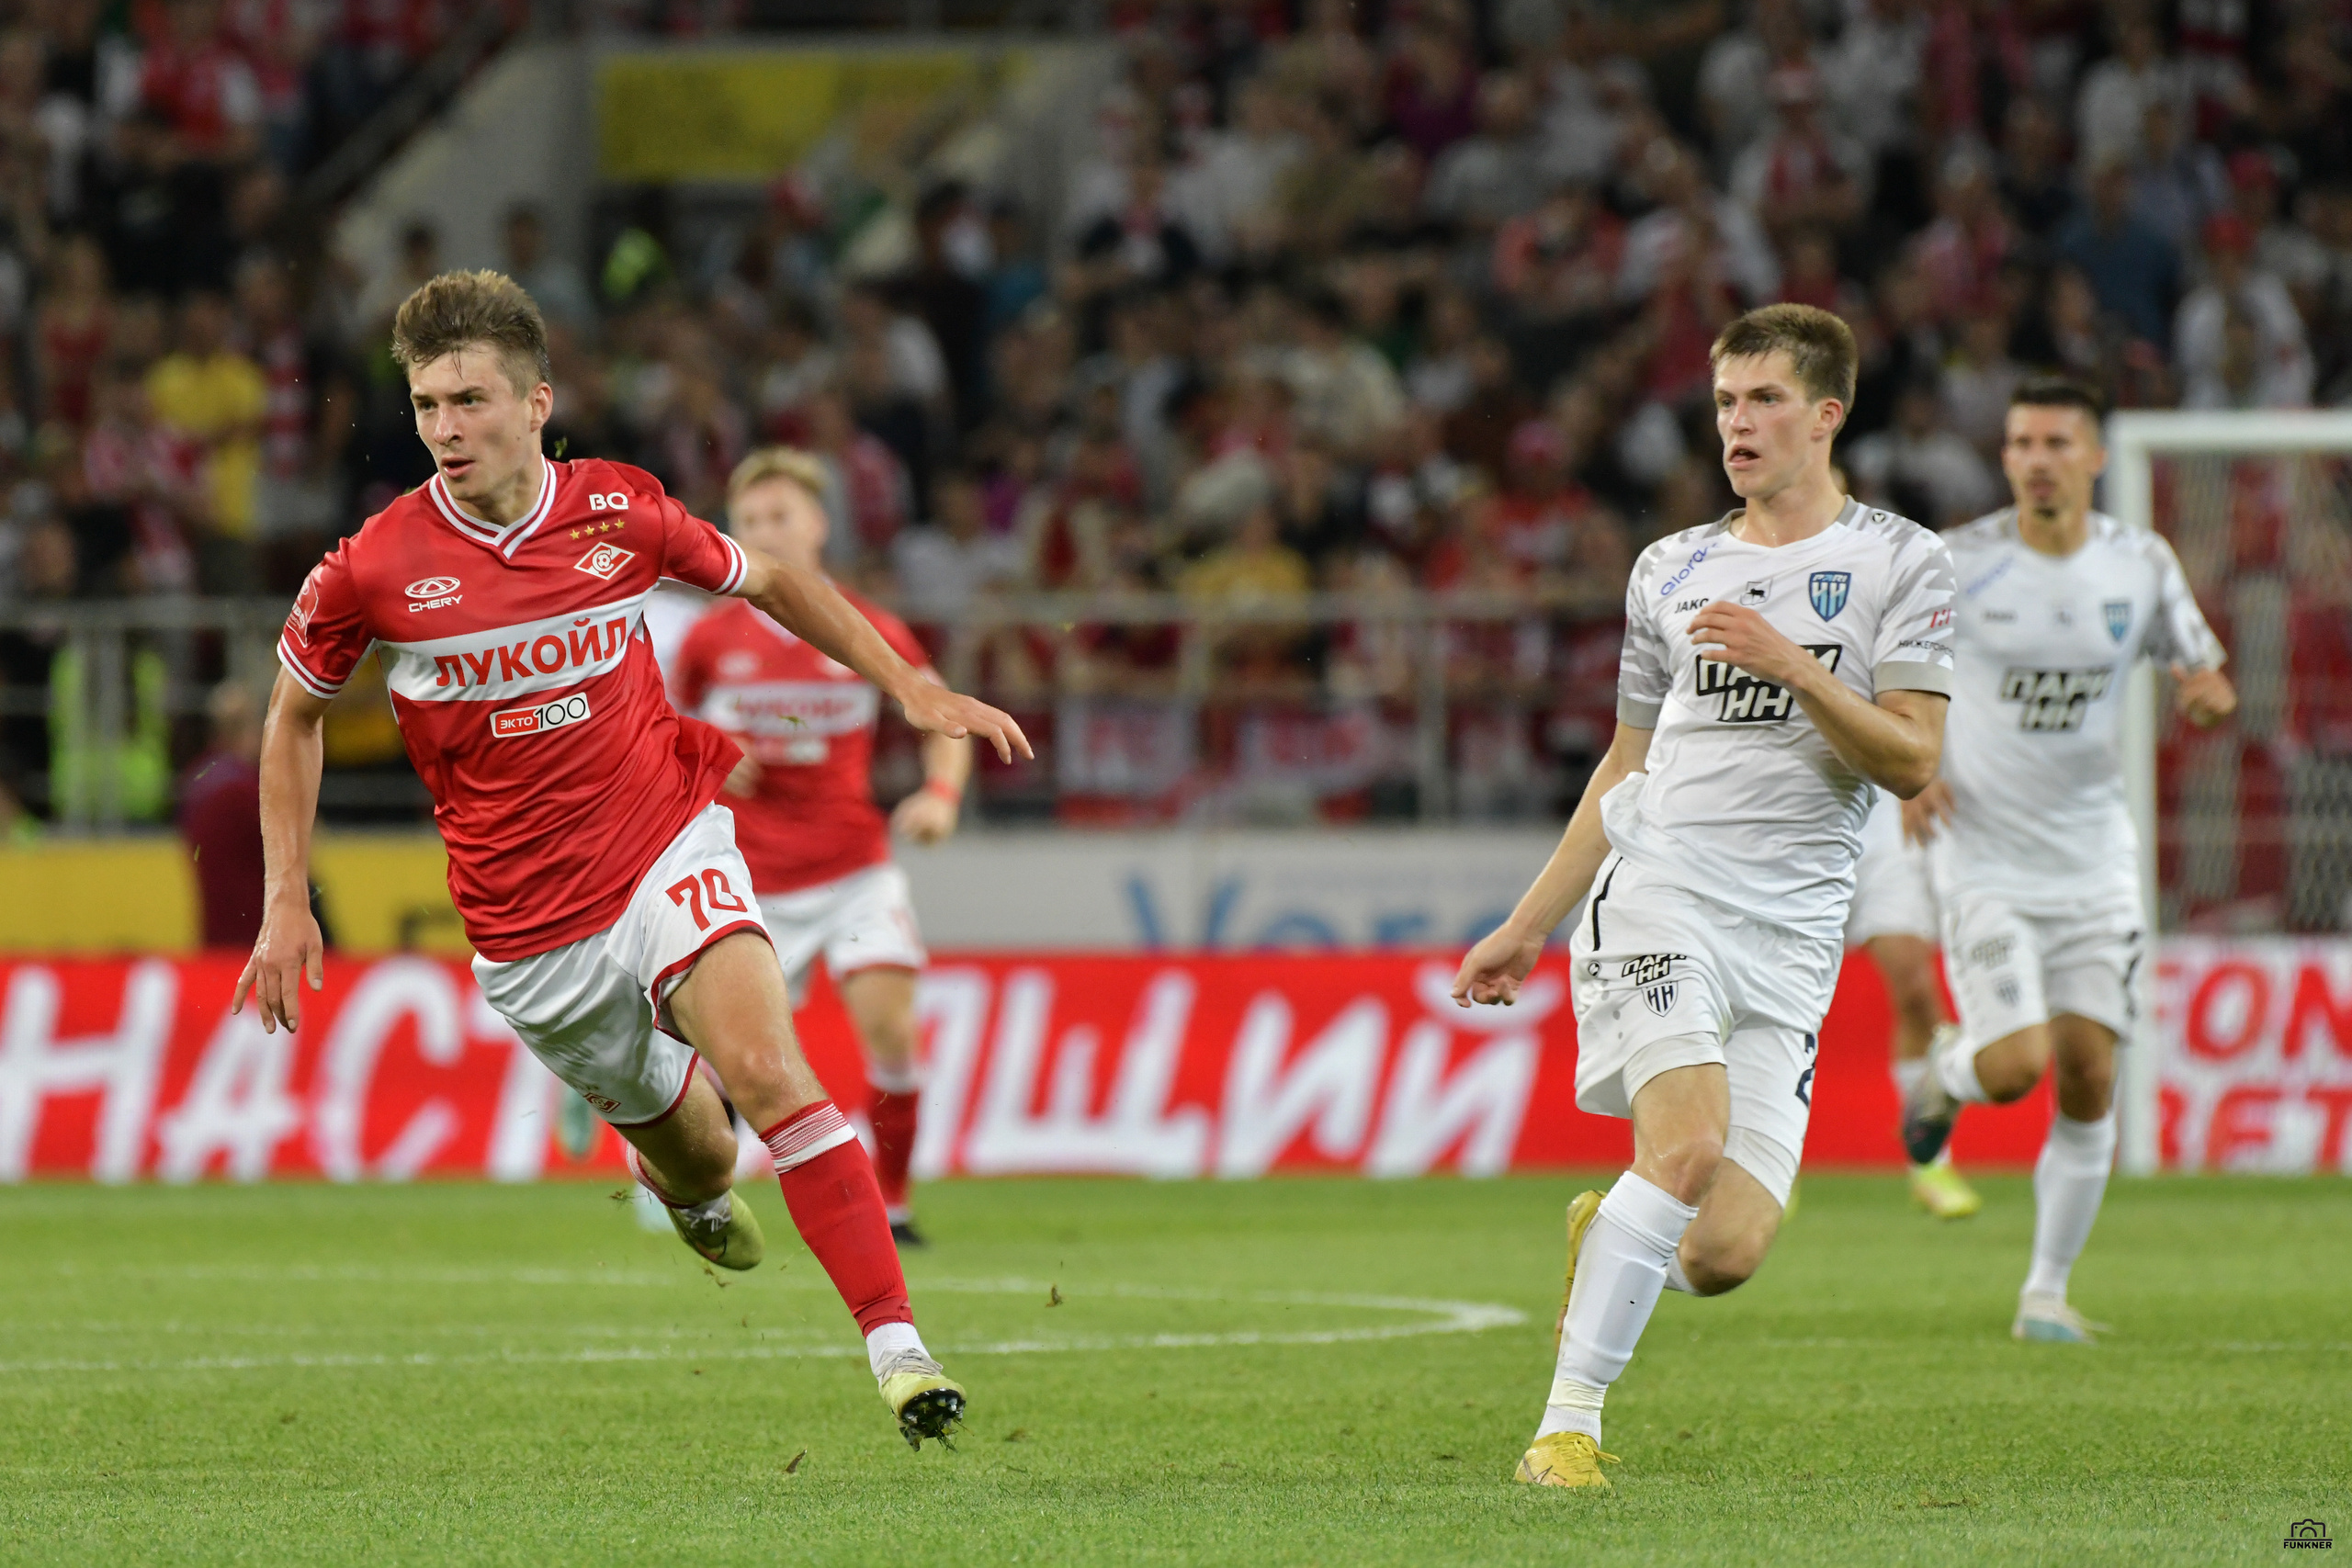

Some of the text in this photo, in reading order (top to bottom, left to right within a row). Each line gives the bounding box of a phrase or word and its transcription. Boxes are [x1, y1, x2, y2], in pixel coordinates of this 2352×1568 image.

[589, 491, 629, 511] BQ
[408, 594, 463, 613] CHERY
[434, 616, 627, 687] ЛУКОЙЛ
[664, 868, 749, 932] 70
